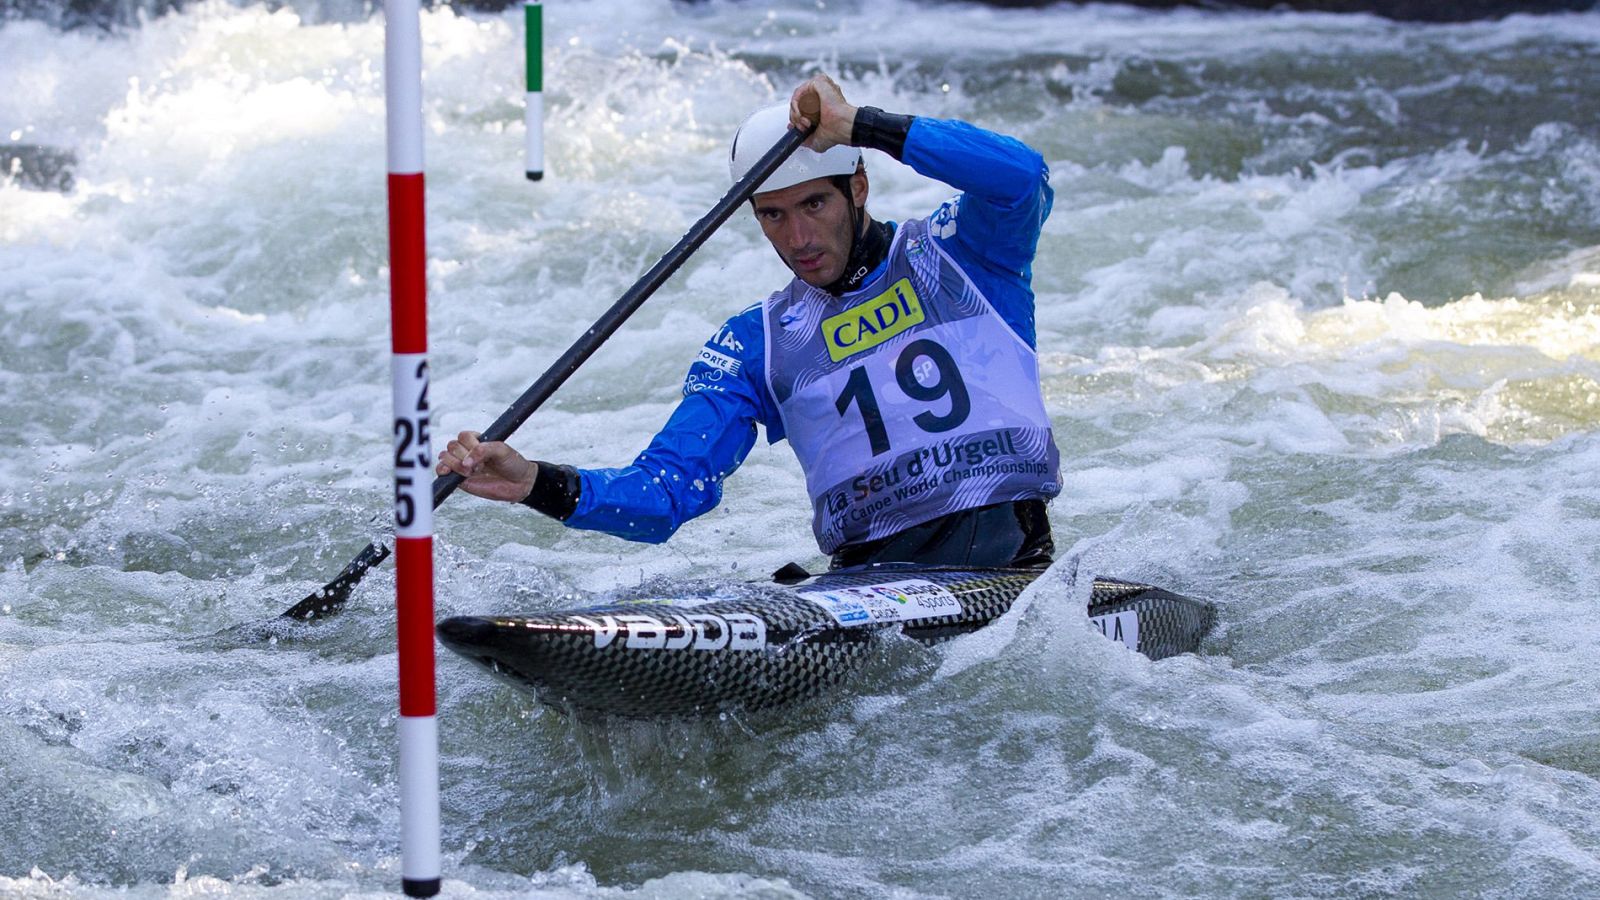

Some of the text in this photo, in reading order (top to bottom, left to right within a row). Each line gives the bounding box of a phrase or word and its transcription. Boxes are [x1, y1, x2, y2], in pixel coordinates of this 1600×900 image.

[834, 338, 971, 458] 19
[826, 430, 1017, 516] La Seu d'Urgell
[851, 496, 892, 521] Canoe
[893, 476, 938, 500] World
[943, 459, 1049, 484] Championships
[916, 594, 956, 612] 4Sports
